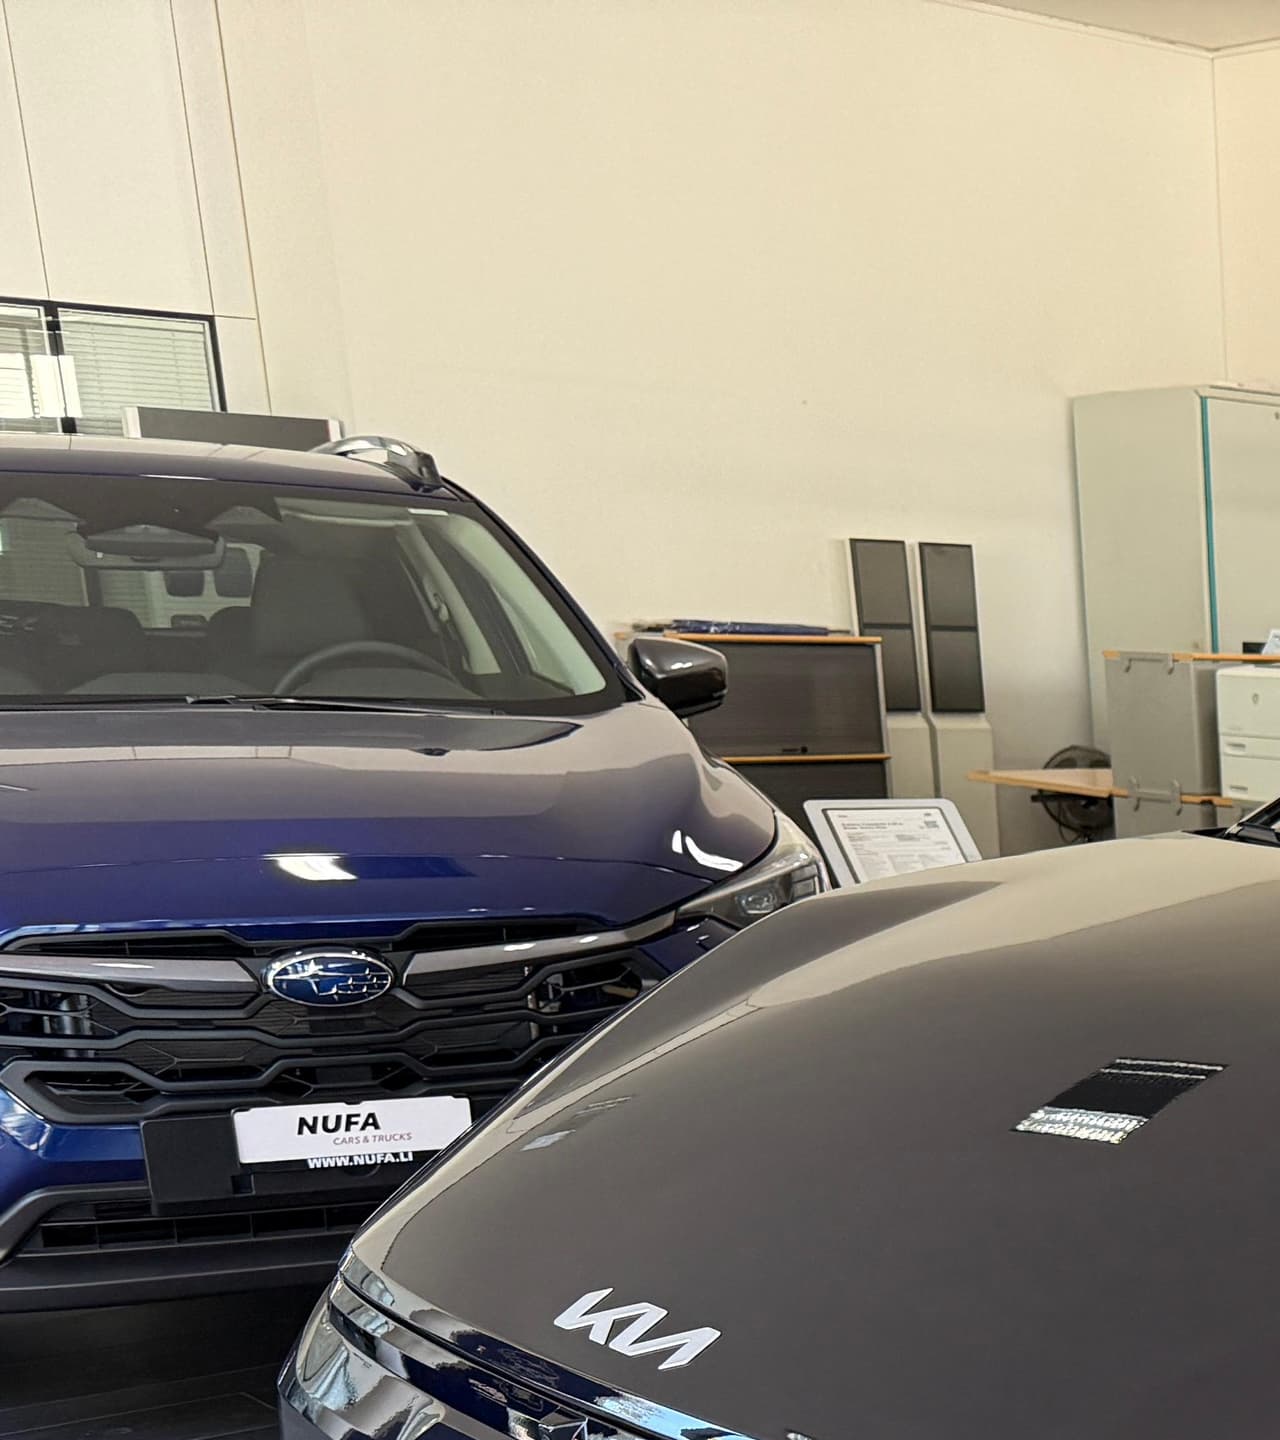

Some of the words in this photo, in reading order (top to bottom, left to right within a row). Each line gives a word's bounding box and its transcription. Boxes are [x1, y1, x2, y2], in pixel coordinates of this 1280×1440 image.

[297, 1112, 381, 1136] NUFA
[333, 1137, 361, 1146] CARS
[363, 1135, 371, 1144] &
[372, 1132, 413, 1143] TRUCKS
[307, 1151, 413, 1169] WWW.NUFA.LI
[554, 1287, 722, 1370] KIA
